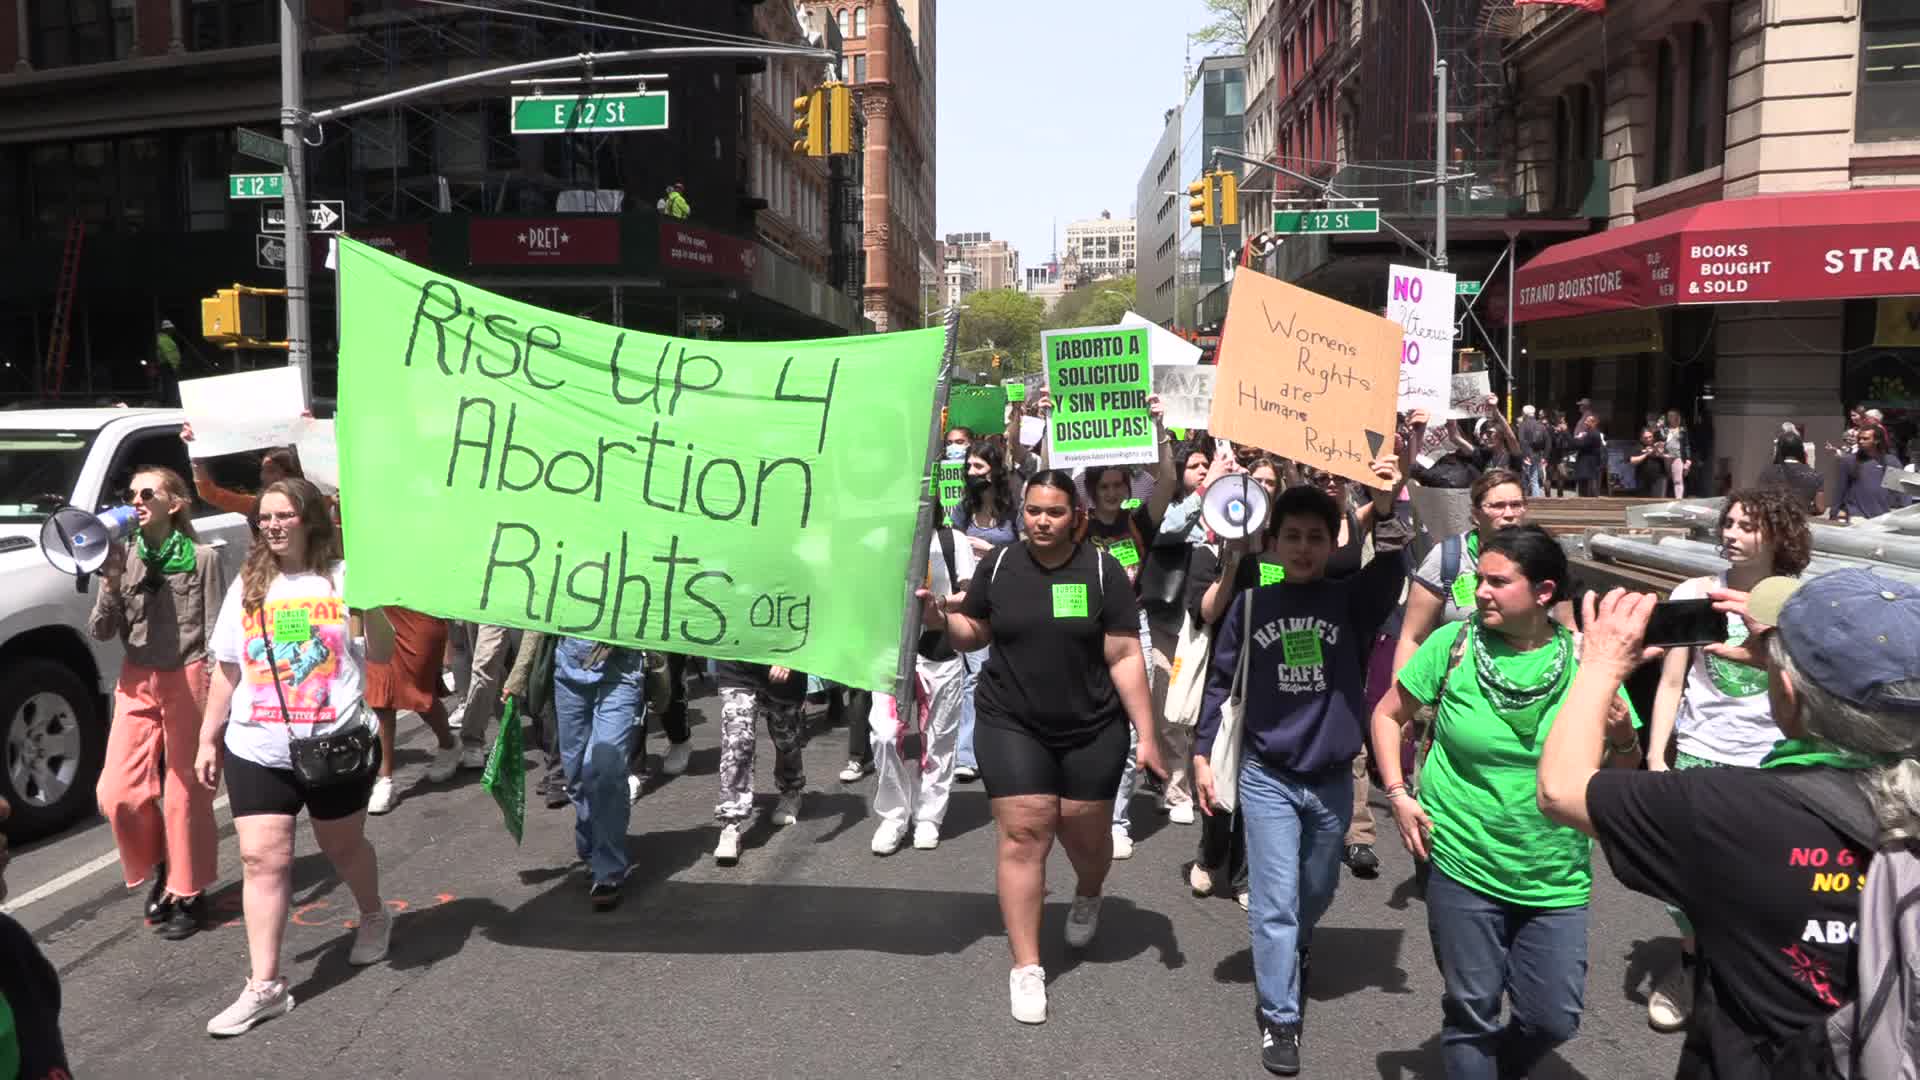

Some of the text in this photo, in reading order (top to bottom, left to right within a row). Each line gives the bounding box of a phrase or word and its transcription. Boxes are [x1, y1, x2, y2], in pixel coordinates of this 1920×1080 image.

[554, 102, 625, 124] E 12 St
[236, 178, 245, 195] E
[251, 178, 265, 195] 12
[1301, 214, 1349, 229] E 12 St
[529, 227, 560, 249] PRET
[1691, 244, 1749, 258] BOOKS
[1700, 261, 1772, 275] BOUGHT
[1393, 275, 1423, 303] NO
[1519, 270, 1623, 305] STRAND BOOKSTORE
[1688, 280, 1748, 294] & SOLD
[1056, 335, 1140, 361] ¡ABORTO A
[405, 280, 566, 390] Rise
[774, 355, 841, 454] 4
[1058, 362, 1140, 387] SOLICITUD
[1297, 346, 1371, 395] Rights
[1055, 389, 1148, 413] Y SIN PEDIR
[1280, 383, 1312, 403] are
[1056, 416, 1148, 442] DISCULPAS!
[1305, 426, 1362, 463] Rights
[446, 395, 813, 528] Abortion
[1278, 663, 1324, 682] CAFE
[1789, 848, 1829, 867] NO
[1812, 873, 1850, 892] NO
